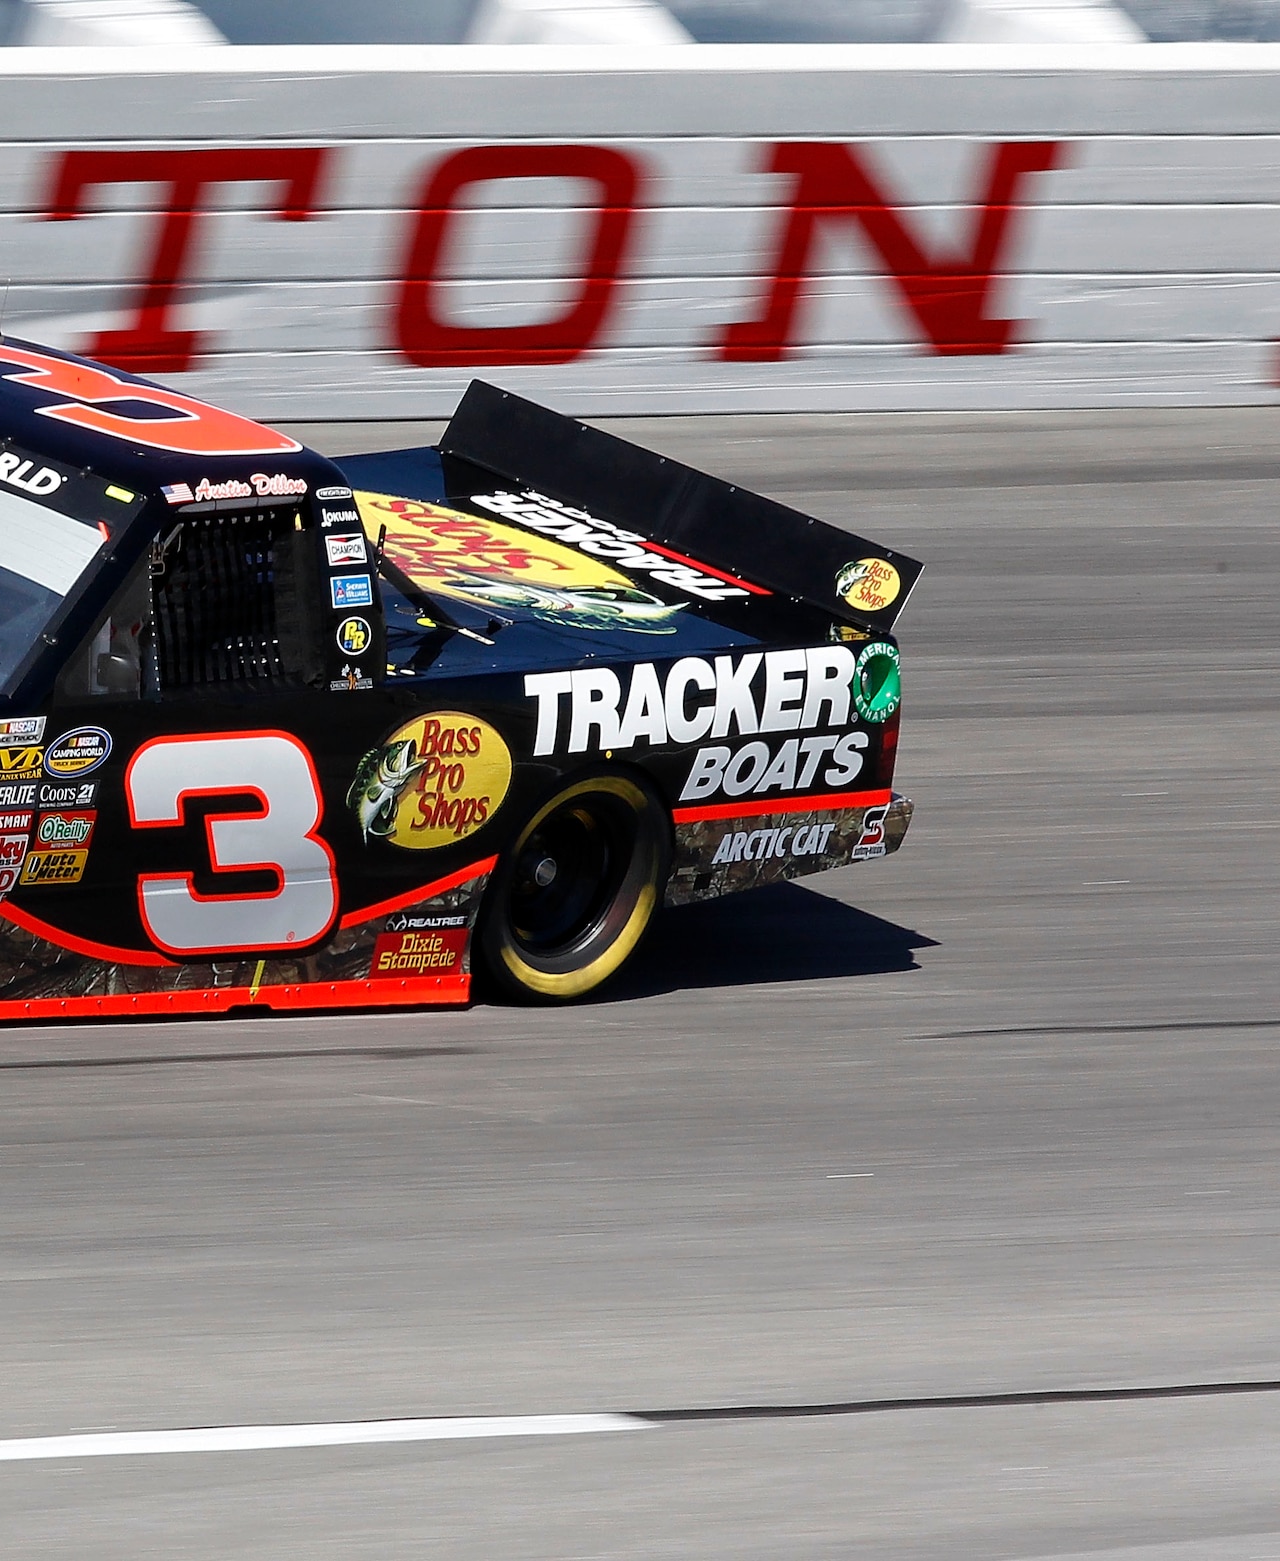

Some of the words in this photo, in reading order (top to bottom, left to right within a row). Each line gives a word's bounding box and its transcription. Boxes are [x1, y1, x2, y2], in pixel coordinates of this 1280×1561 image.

[195, 478, 252, 501] Austin
[250, 473, 308, 496] Dillon
[332, 545, 363, 554] CHAMPION
[470, 494, 750, 601] TRACKER
[868, 561, 894, 582] Bass
[855, 587, 887, 608] Shops
[524, 645, 858, 757] TRACKER
[856, 694, 900, 721] ETHANOL
[9, 720, 37, 733] NASCAR
[13, 734, 39, 742] TRUCK
[418, 719, 482, 757] Bass
[52, 749, 81, 758] CAMPING
[80, 747, 104, 757] WORLD
[19, 768, 42, 779] WEAR
[416, 758, 465, 794] Pro
[679, 731, 868, 801] BOATS
[39, 784, 76, 802] Coors
[77, 783, 95, 798] 21
[410, 792, 490, 834] Shops
[40, 816, 91, 842] O'Reilly
[124, 729, 340, 957] 3
[711, 826, 786, 864] ARCTIC
[789, 823, 835, 858] CAT
[42, 854, 76, 866] Auto
[37, 866, 80, 879] Meter
[407, 916, 465, 927] REALTREE
[399, 933, 443, 953] Dixie
[378, 949, 456, 973] Stampede
